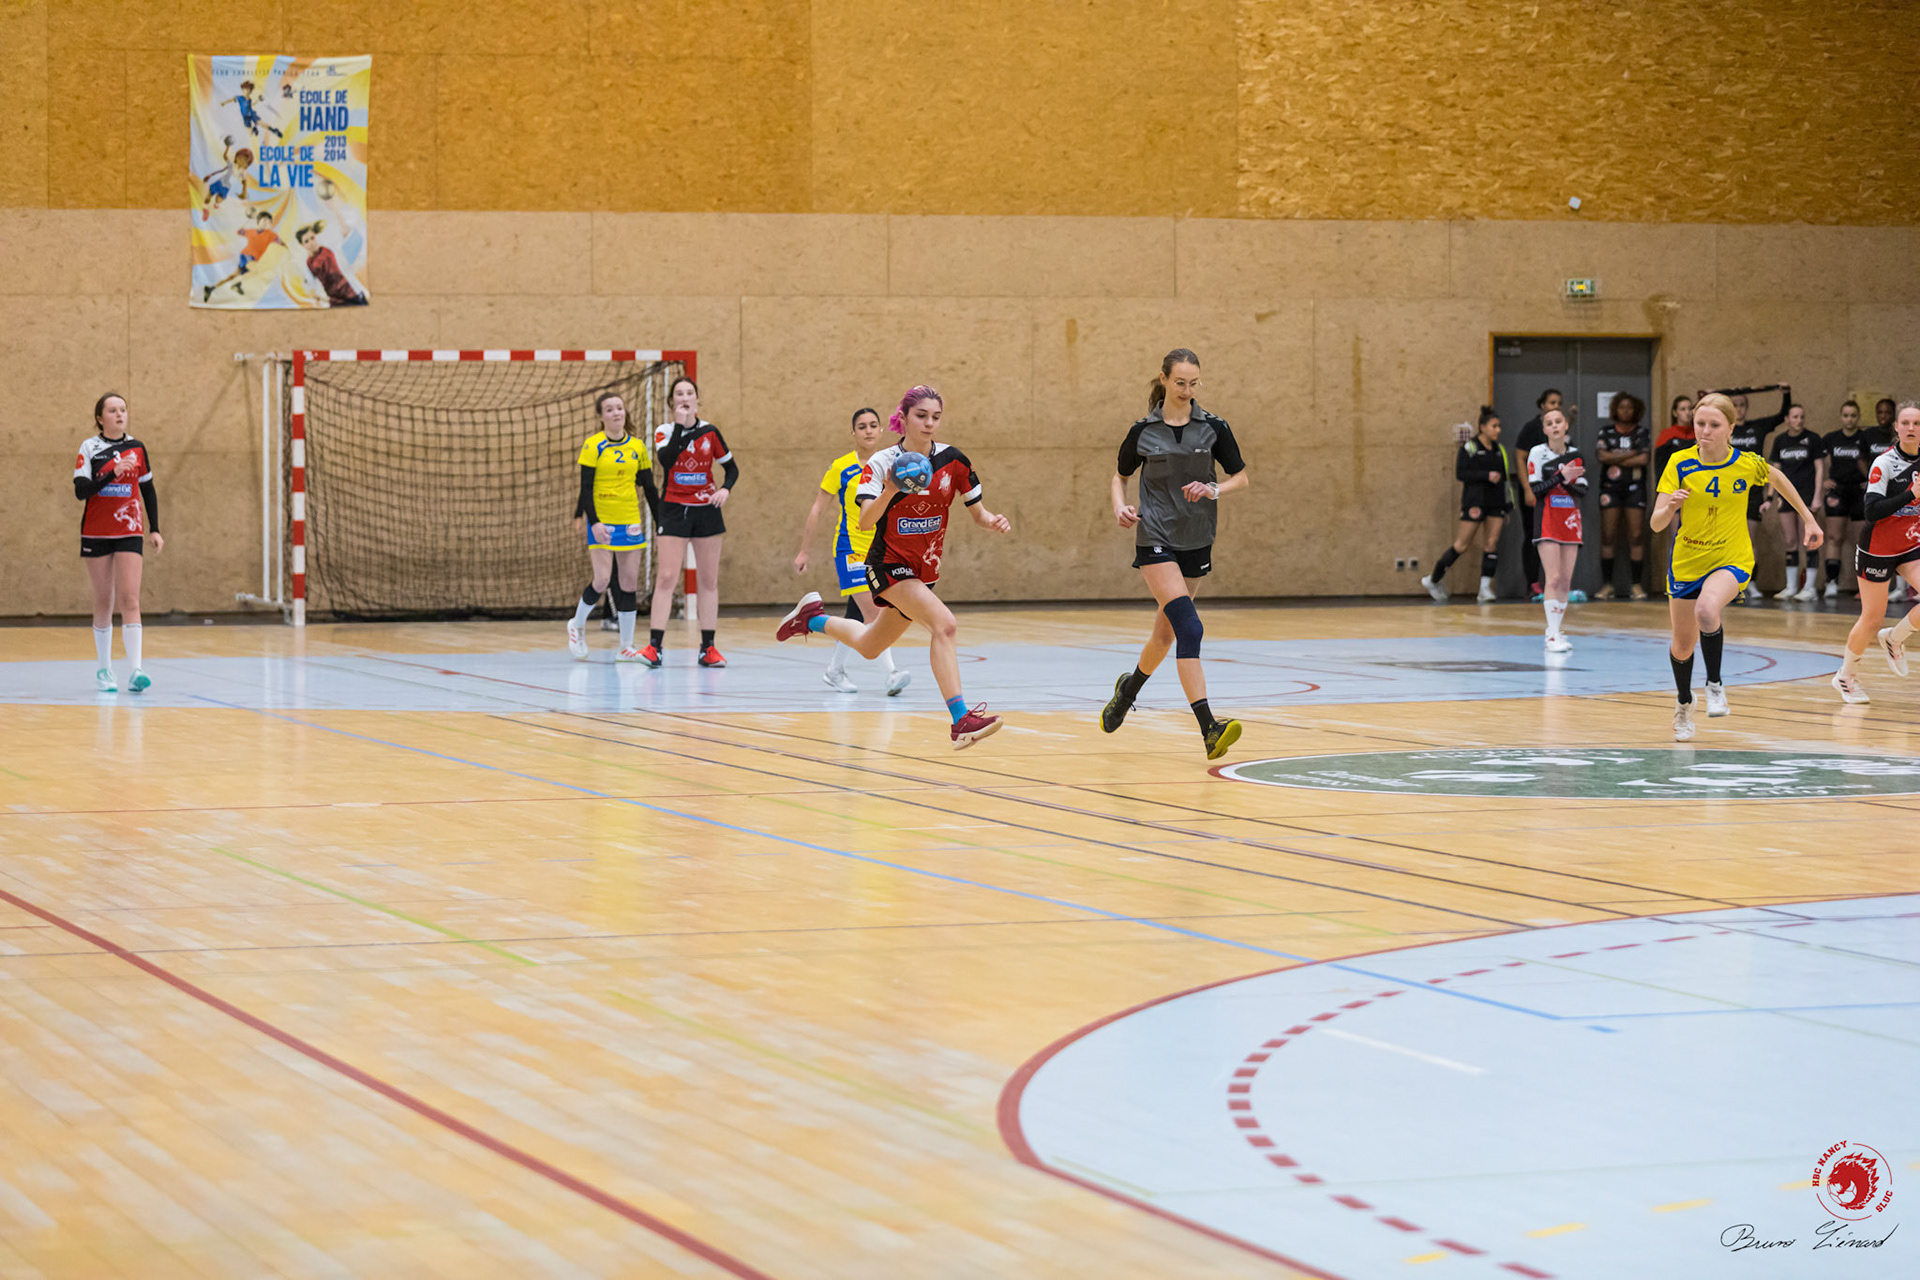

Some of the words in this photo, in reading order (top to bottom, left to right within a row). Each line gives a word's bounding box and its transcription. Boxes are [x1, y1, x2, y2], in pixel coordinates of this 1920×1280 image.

[335, 90, 348, 104] DE
[300, 106, 349, 131] HAND
[324, 135, 347, 148] 2013
[300, 146, 314, 162] DE
[324, 149, 347, 162] 2014
[259, 164, 280, 187] LA
[287, 164, 314, 187] VIE
[687, 439, 696, 454] 4
[1833, 446, 1860, 458] Kemp
[113, 450, 121, 464] 3
[614, 450, 625, 463] 2
[1705, 476, 1721, 498] 4
[900, 518, 928, 529] Grand
[928, 518, 940, 527] Est
